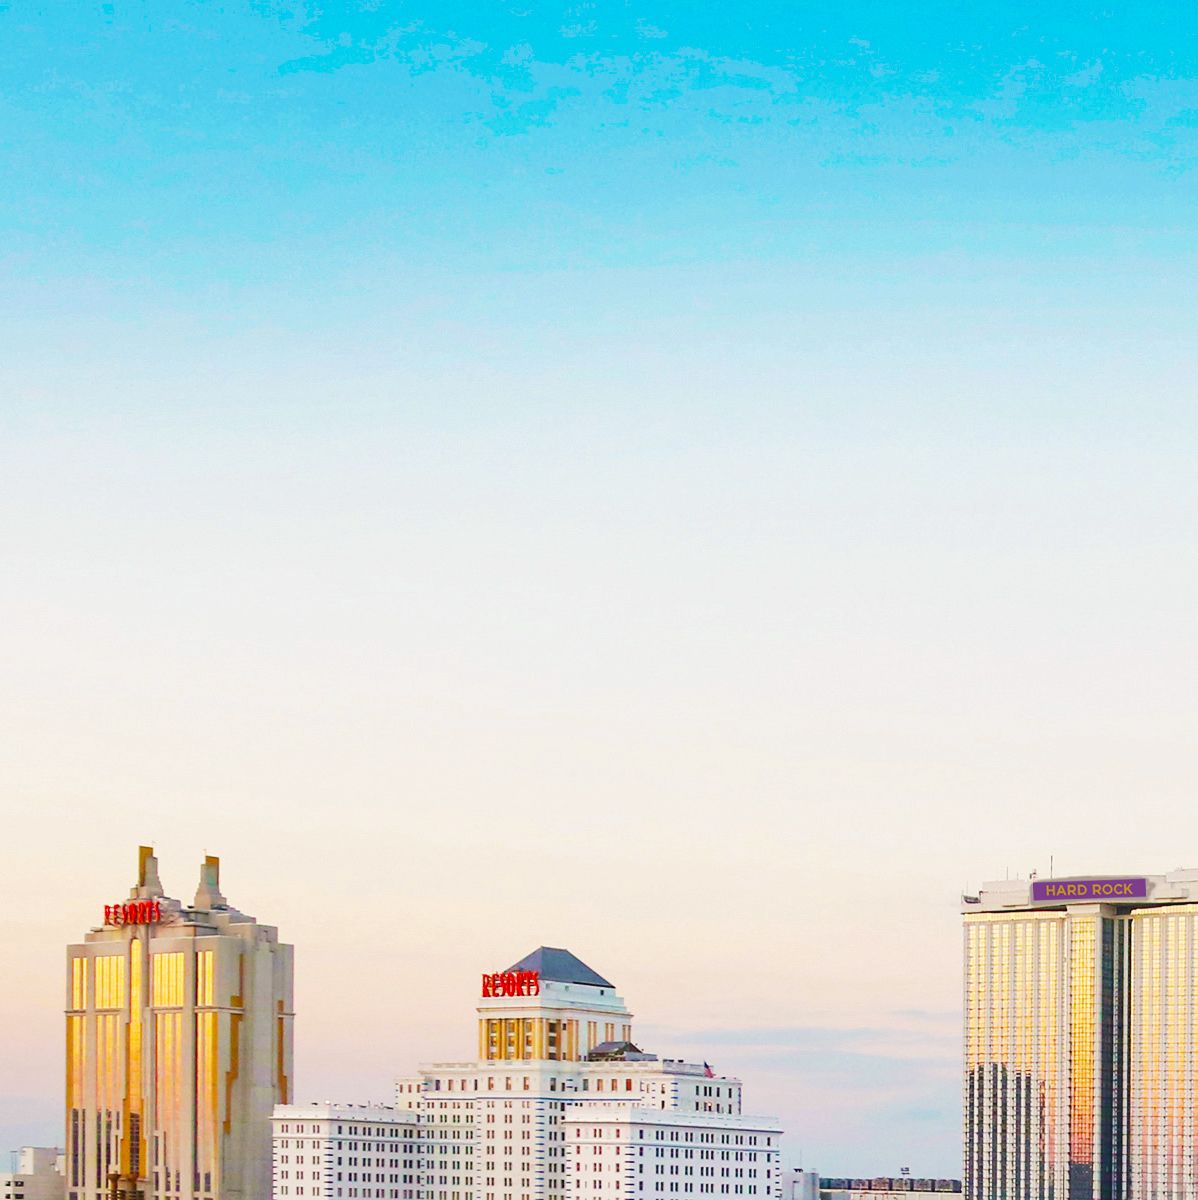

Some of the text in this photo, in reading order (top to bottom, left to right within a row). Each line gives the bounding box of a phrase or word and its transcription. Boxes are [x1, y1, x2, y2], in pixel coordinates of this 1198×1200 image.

[1045, 883, 1133, 896] HARD ROCK
[104, 900, 161, 925] RESORTS
[482, 971, 540, 997] RESORTS
